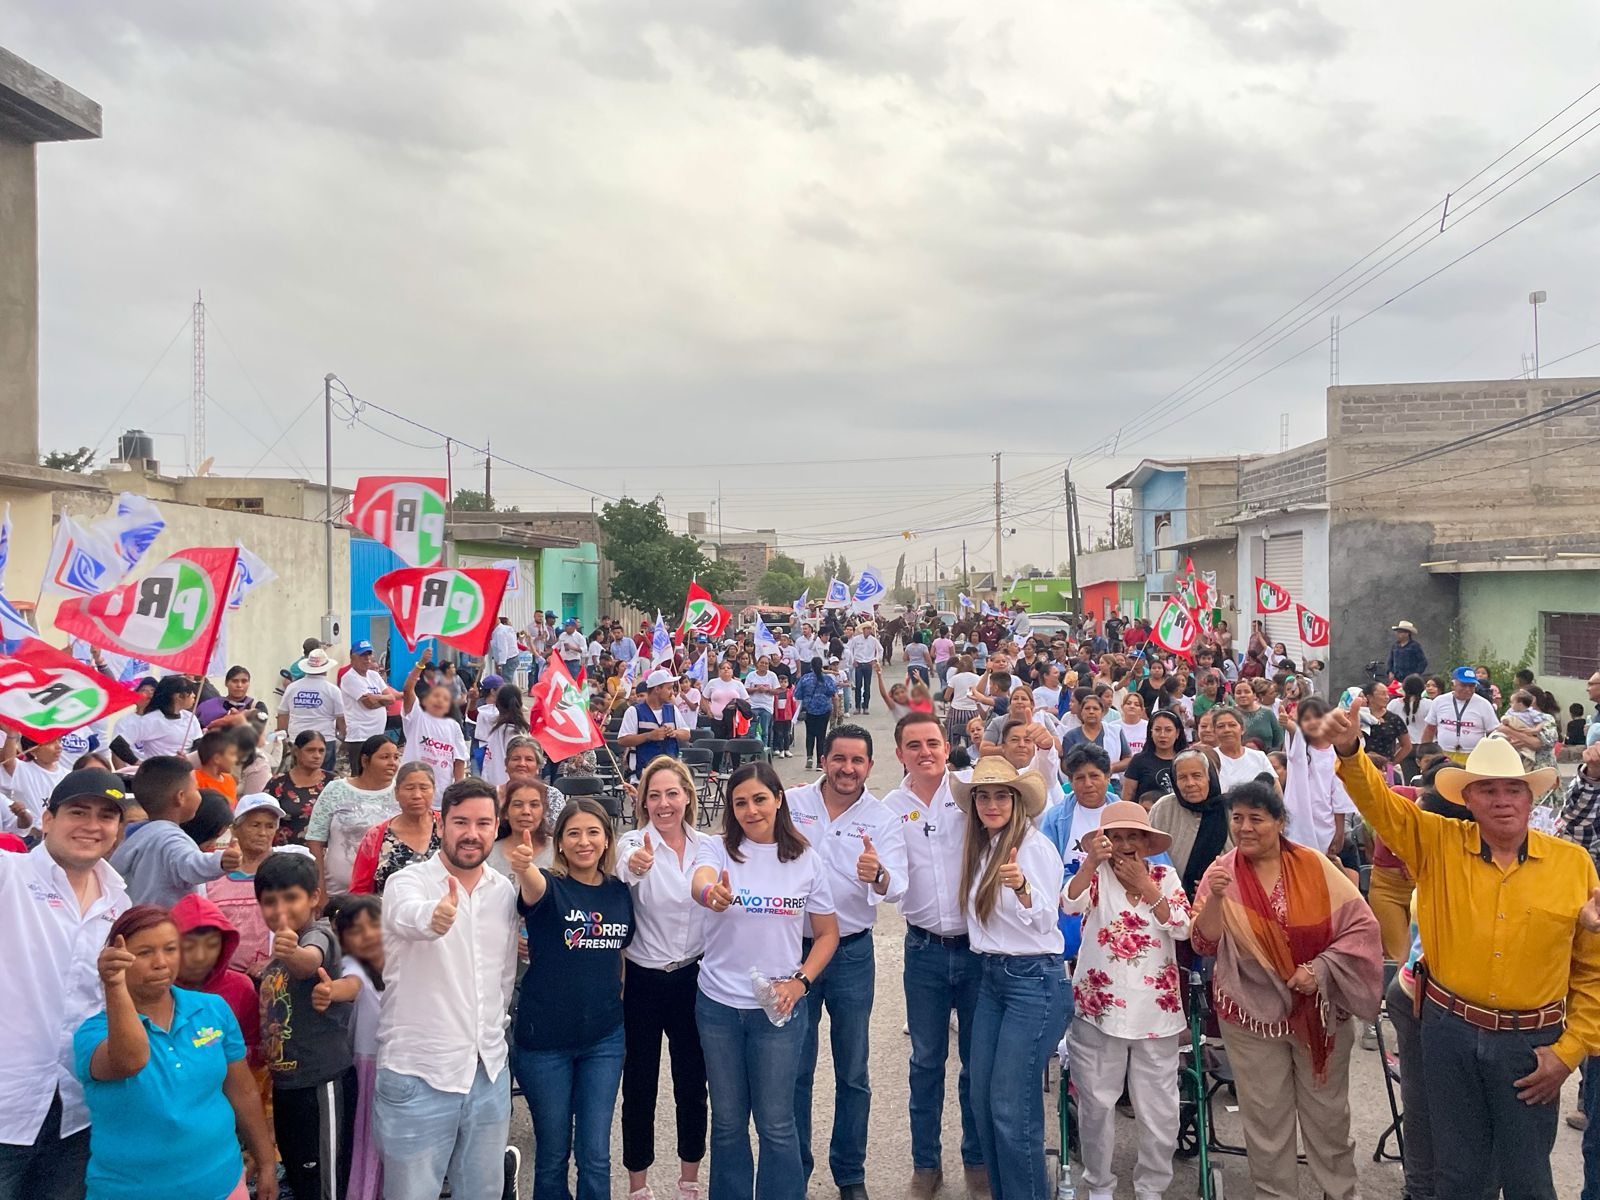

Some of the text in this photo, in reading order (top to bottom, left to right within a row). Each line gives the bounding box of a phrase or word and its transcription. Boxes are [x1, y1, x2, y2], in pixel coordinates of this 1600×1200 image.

[1162, 609, 1194, 641] PRI
[564, 909, 603, 923] JAVO
[583, 923, 629, 937] TORRE
